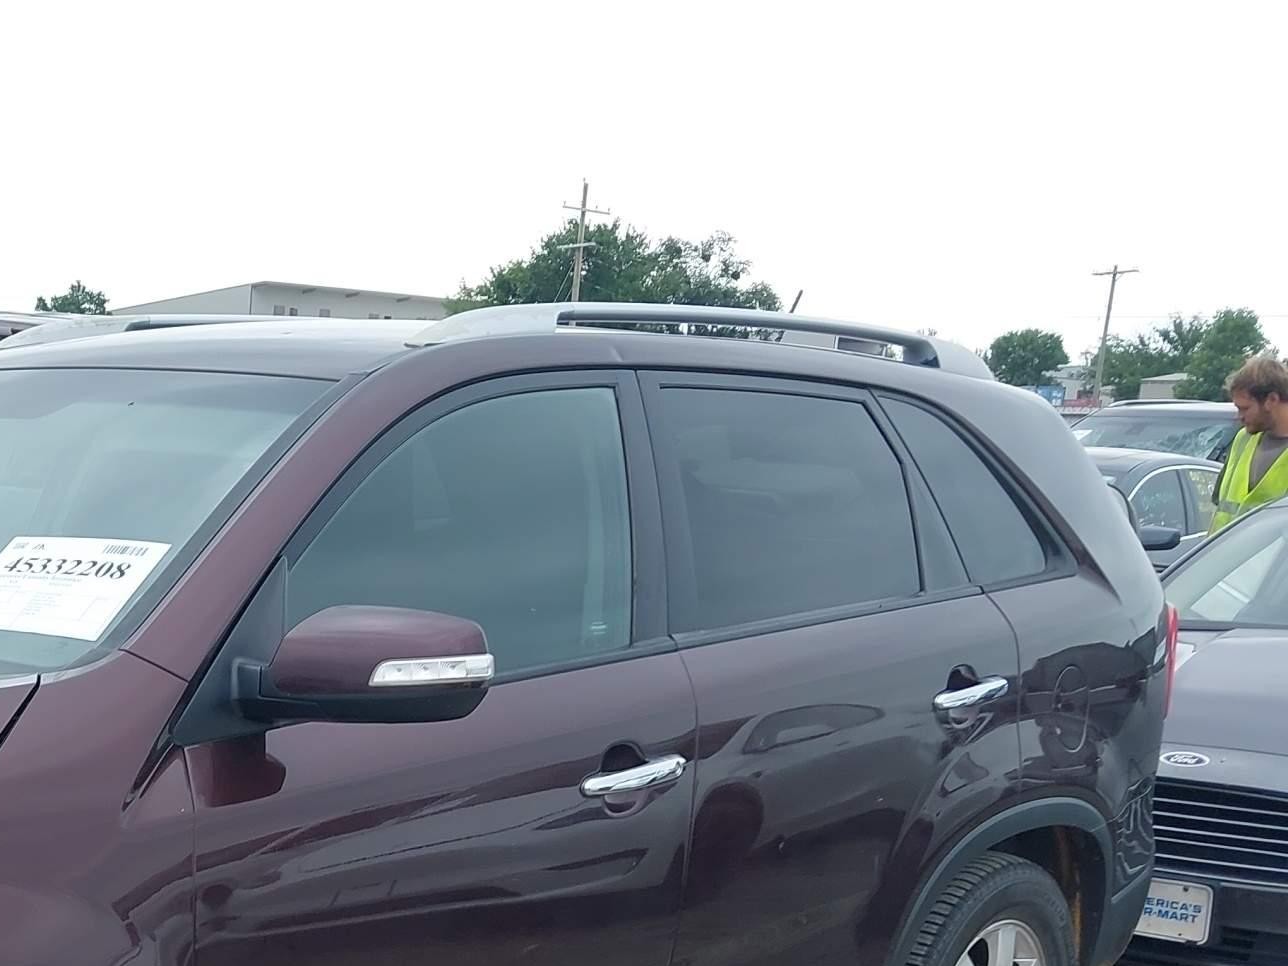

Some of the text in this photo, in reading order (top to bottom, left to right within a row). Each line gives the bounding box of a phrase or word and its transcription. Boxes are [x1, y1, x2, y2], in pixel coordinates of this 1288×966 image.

[3, 556, 132, 580] 45332208
[1144, 896, 1201, 914] ERICA'S
[1143, 907, 1199, 923] R-MART
